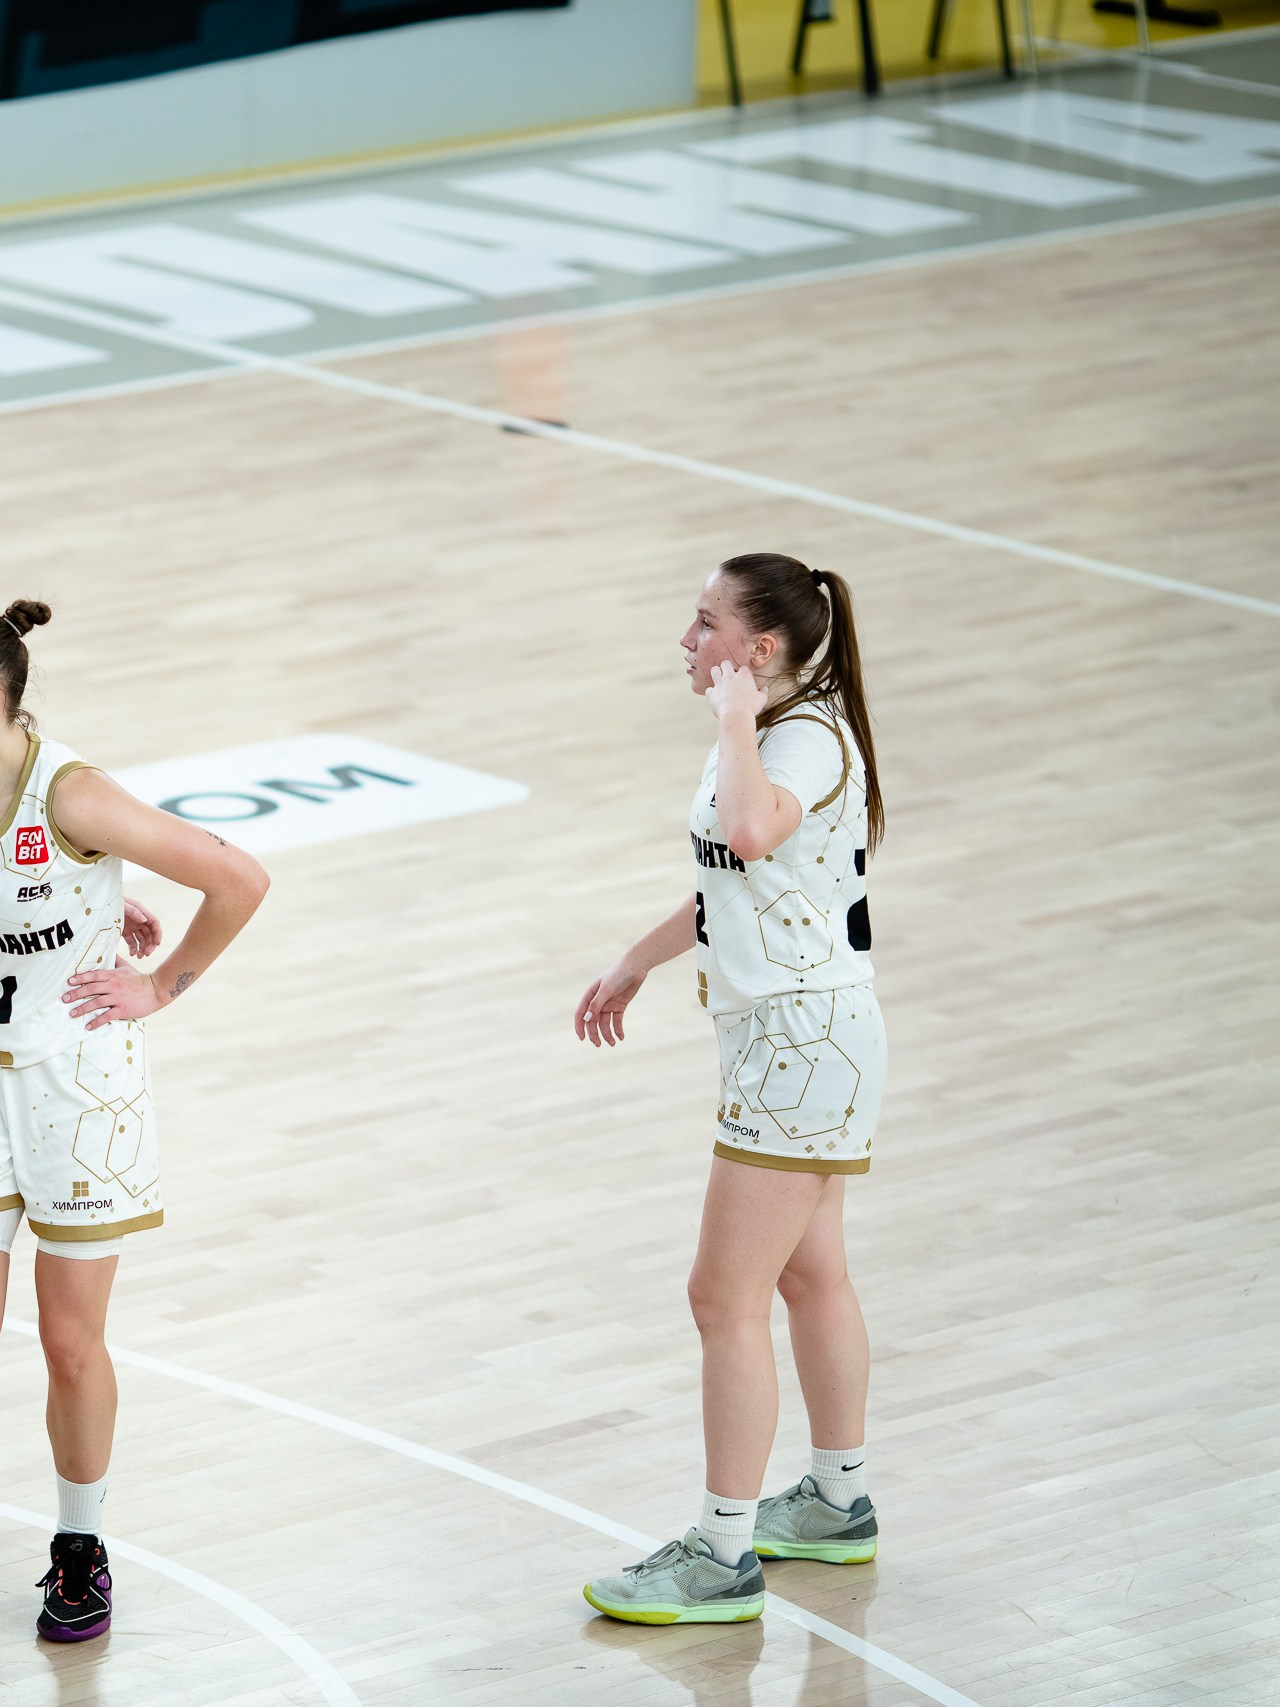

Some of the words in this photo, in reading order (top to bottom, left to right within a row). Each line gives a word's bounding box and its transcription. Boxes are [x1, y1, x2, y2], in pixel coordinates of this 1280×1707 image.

[17, 830, 43, 845] FON
[17, 844, 45, 860] BET
[51, 1199, 113, 1211] ХИМПРОМ
